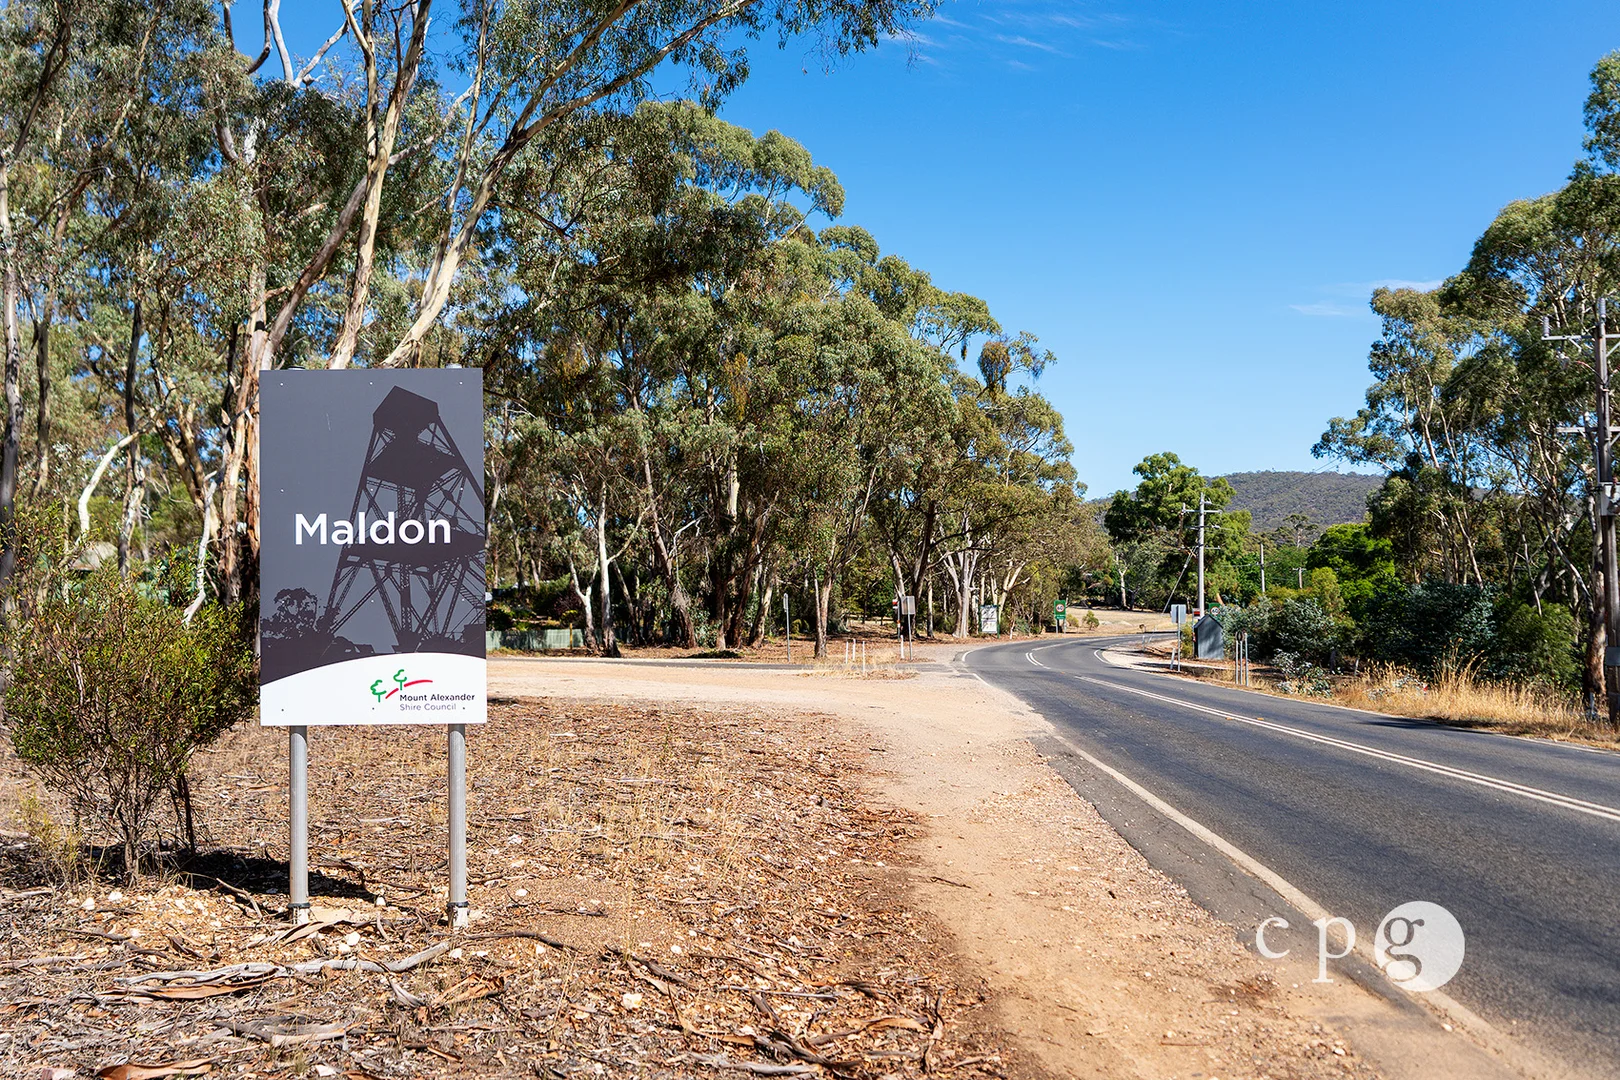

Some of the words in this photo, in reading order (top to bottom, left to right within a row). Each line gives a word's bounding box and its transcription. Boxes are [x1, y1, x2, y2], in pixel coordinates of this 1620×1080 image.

[295, 511, 451, 545] Maldon
[399, 694, 428, 702] Mount
[430, 693, 475, 701] Alexander
[400, 703, 422, 711] Shire
